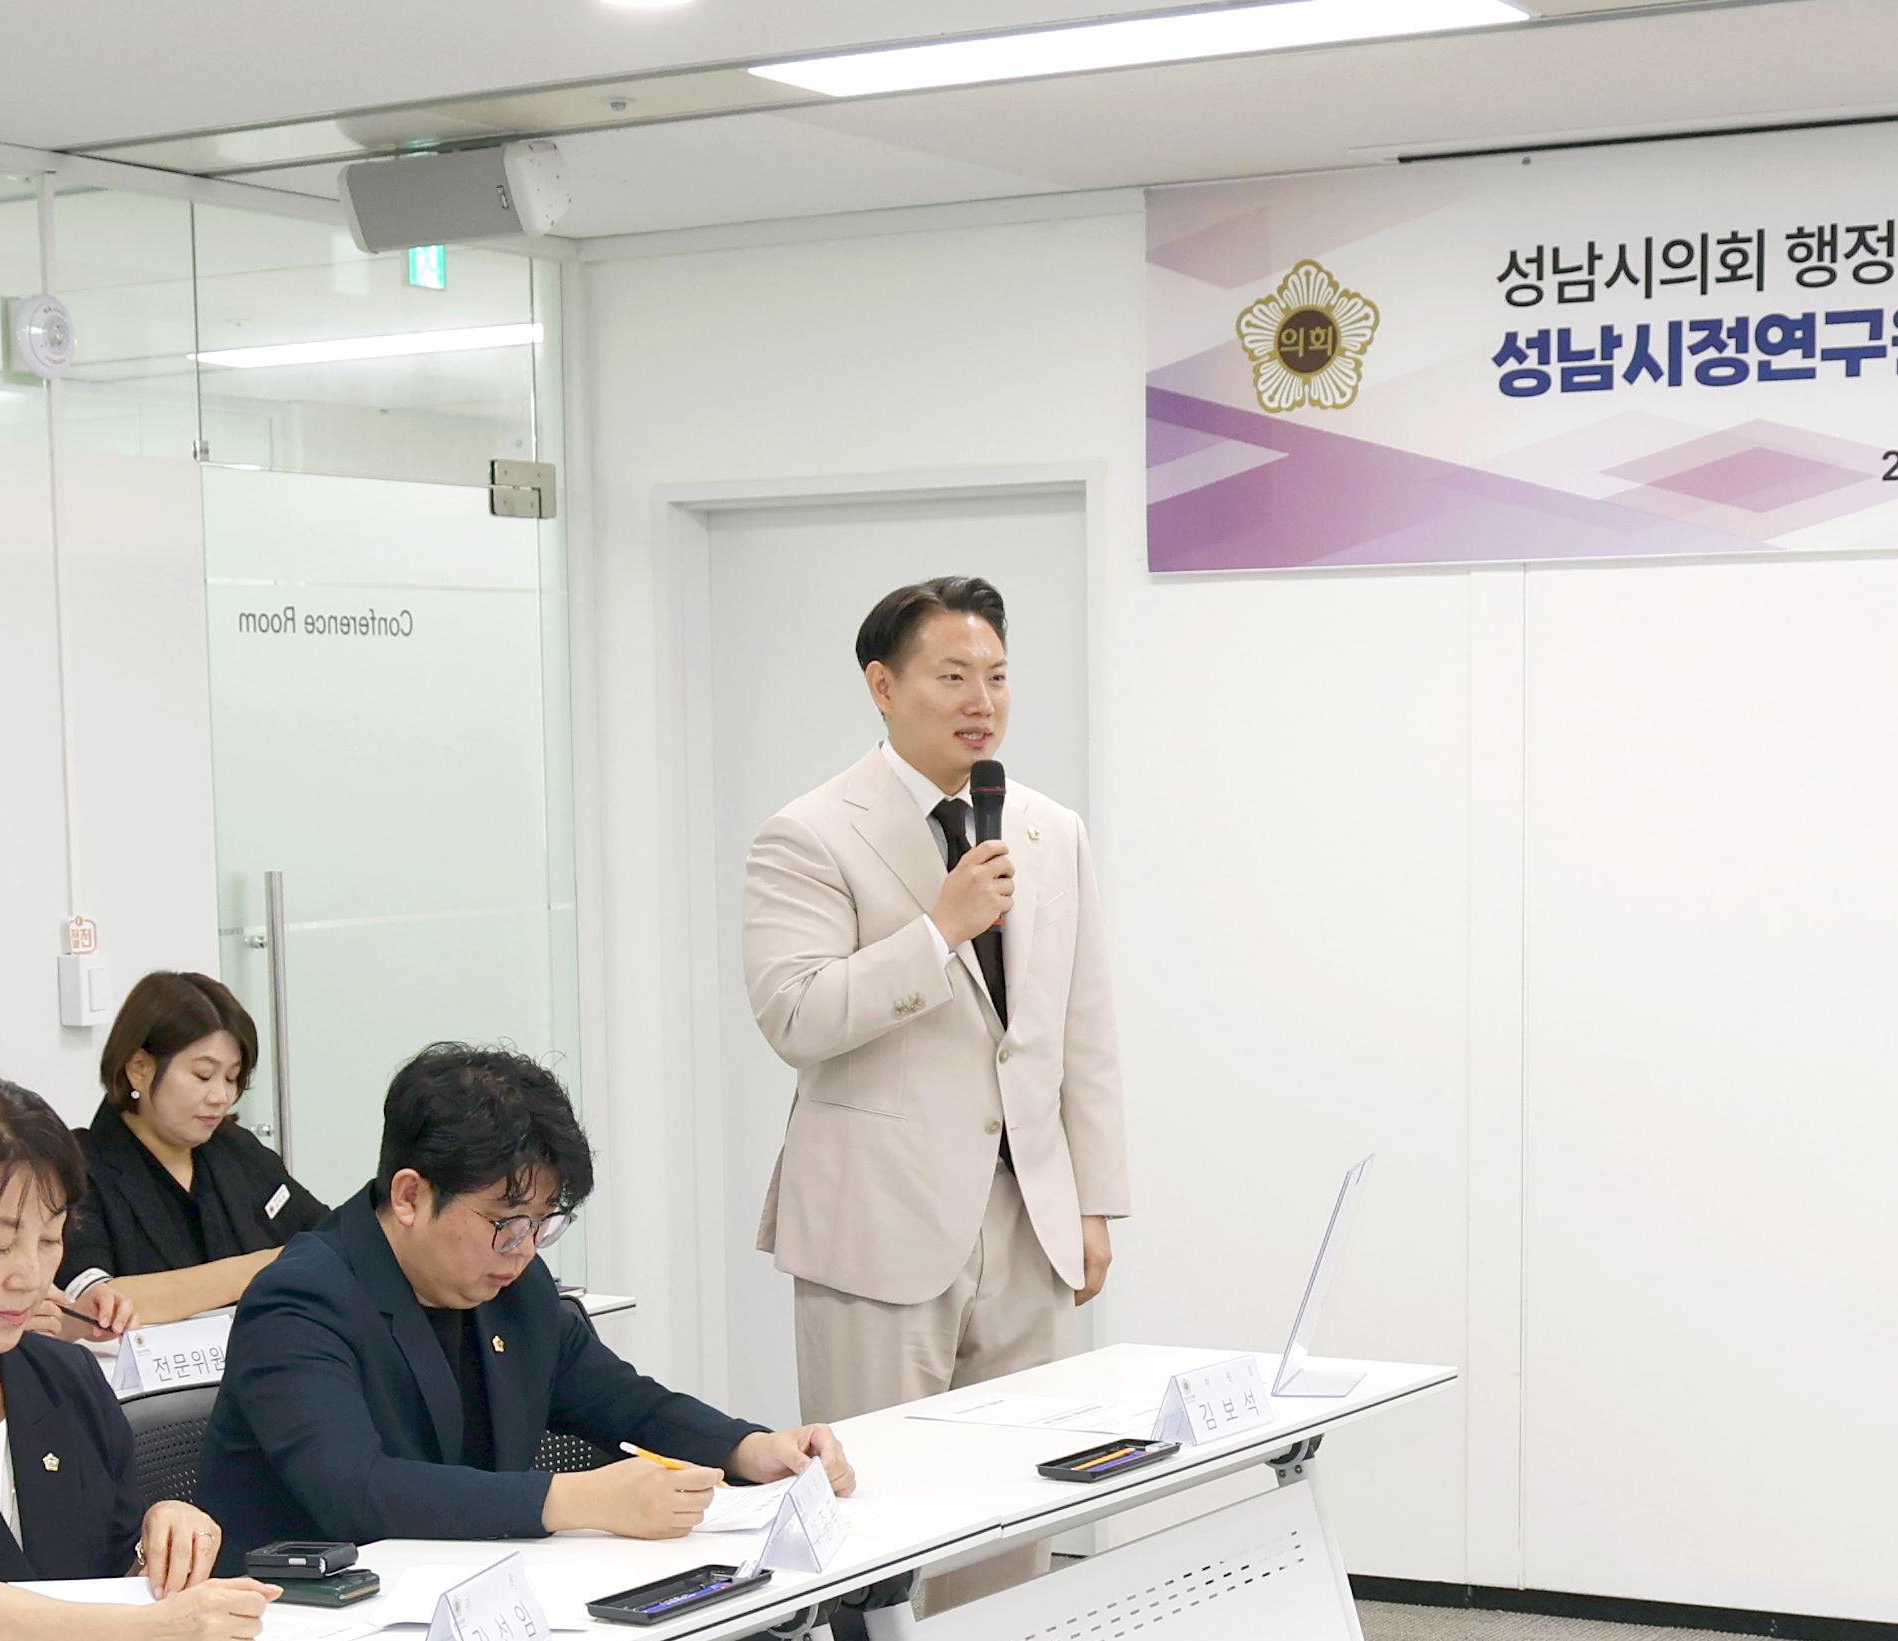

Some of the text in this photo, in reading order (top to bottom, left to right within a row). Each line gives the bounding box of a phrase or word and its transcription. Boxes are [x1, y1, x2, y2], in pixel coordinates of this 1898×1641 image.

[1497, 228, 1766, 307] 성남시의회
[1281, 326, 1333, 358] 의회
[152, 1347, 226, 1381] 전문위원
[1198, 1389, 1259, 1430] 김보석
